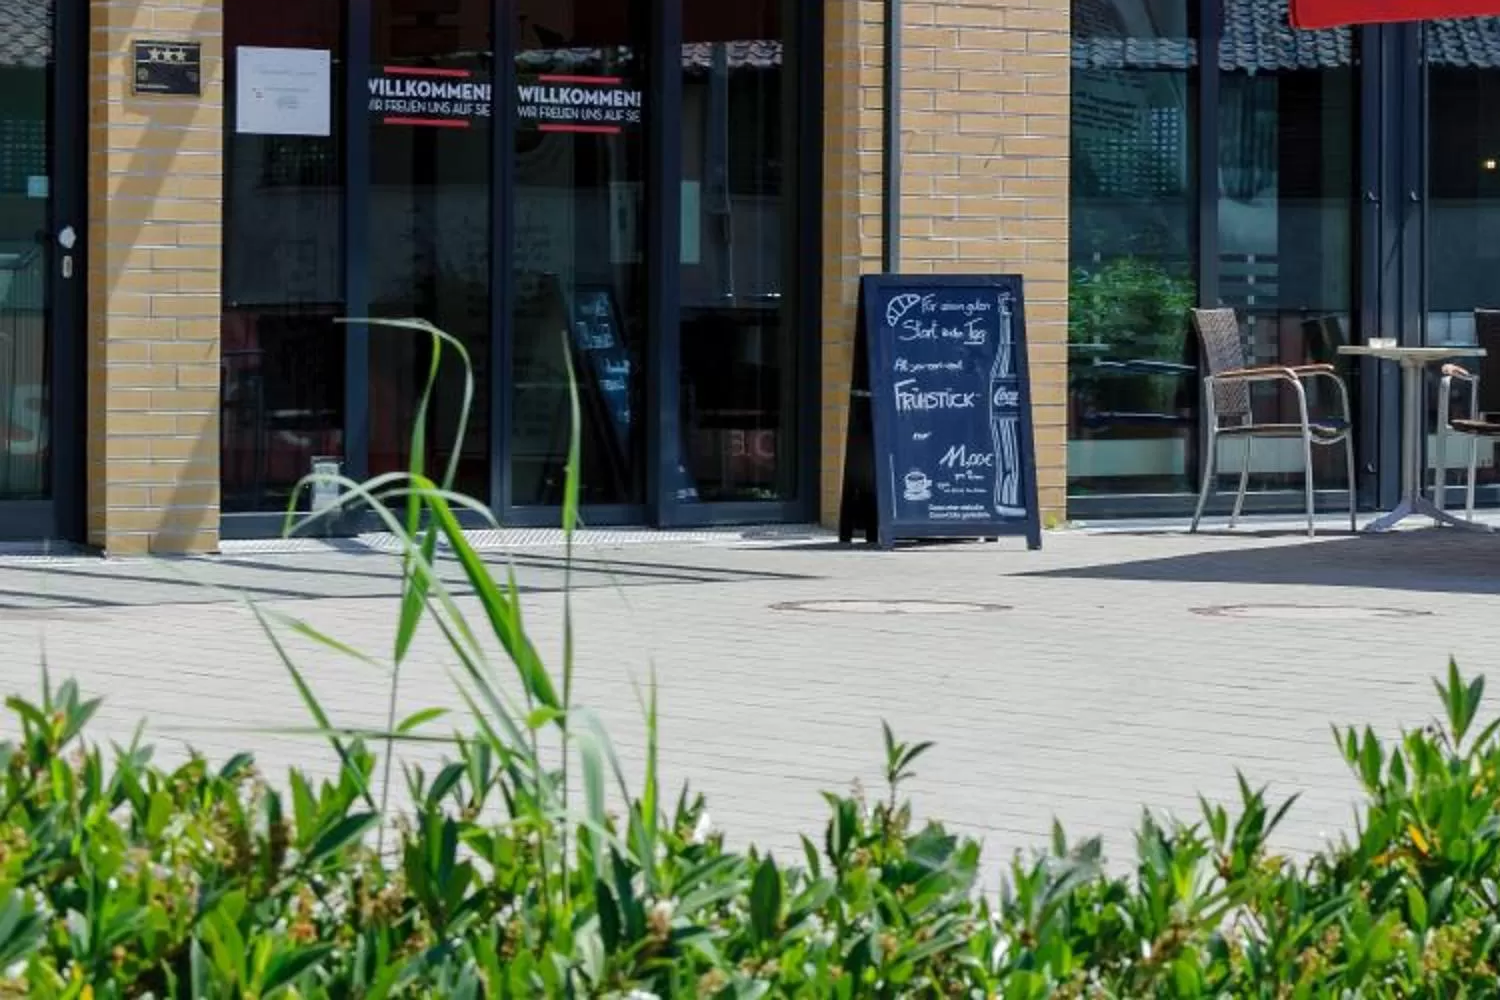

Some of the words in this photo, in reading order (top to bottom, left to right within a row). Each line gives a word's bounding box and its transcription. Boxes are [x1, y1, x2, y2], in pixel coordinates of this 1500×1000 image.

[518, 85, 641, 107] WILLKOMMEN!
[385, 99, 426, 113] FREUEN
[427, 101, 450, 114] UNS
[453, 103, 473, 115] AUF
[476, 104, 491, 117] SIE
[518, 105, 537, 118] WIR
[540, 106, 578, 119] FREUEN
[581, 107, 601, 120] UNS
[604, 109, 624, 120] AUF
[626, 110, 641, 123] SIE
